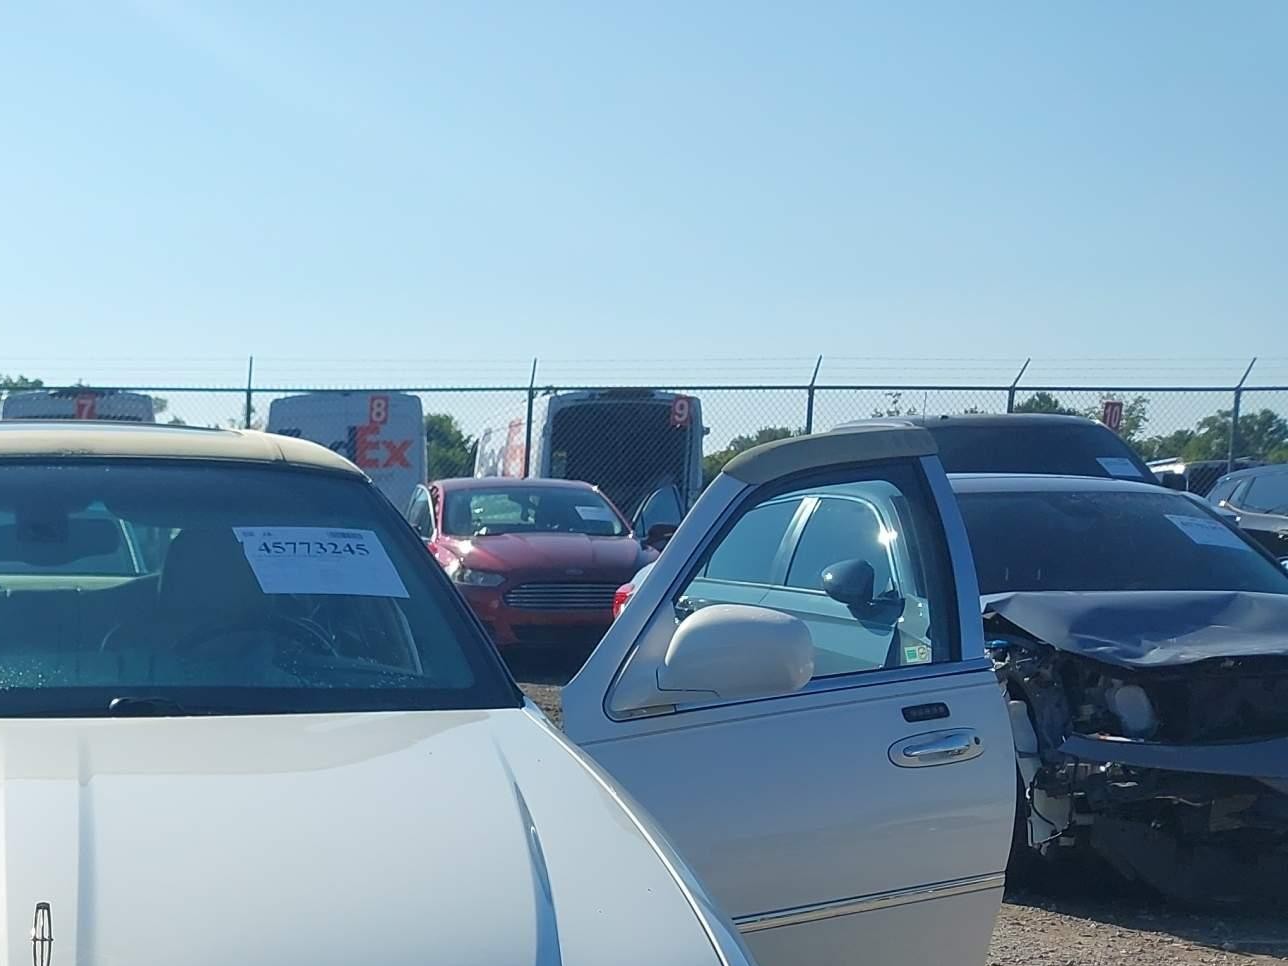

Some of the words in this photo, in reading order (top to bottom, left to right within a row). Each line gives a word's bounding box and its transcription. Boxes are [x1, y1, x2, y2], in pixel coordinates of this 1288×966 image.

[78, 399, 91, 420] 7
[371, 398, 387, 422] 8
[673, 399, 690, 422] 9
[1105, 403, 1121, 428] 10
[258, 541, 370, 556] 45773245
